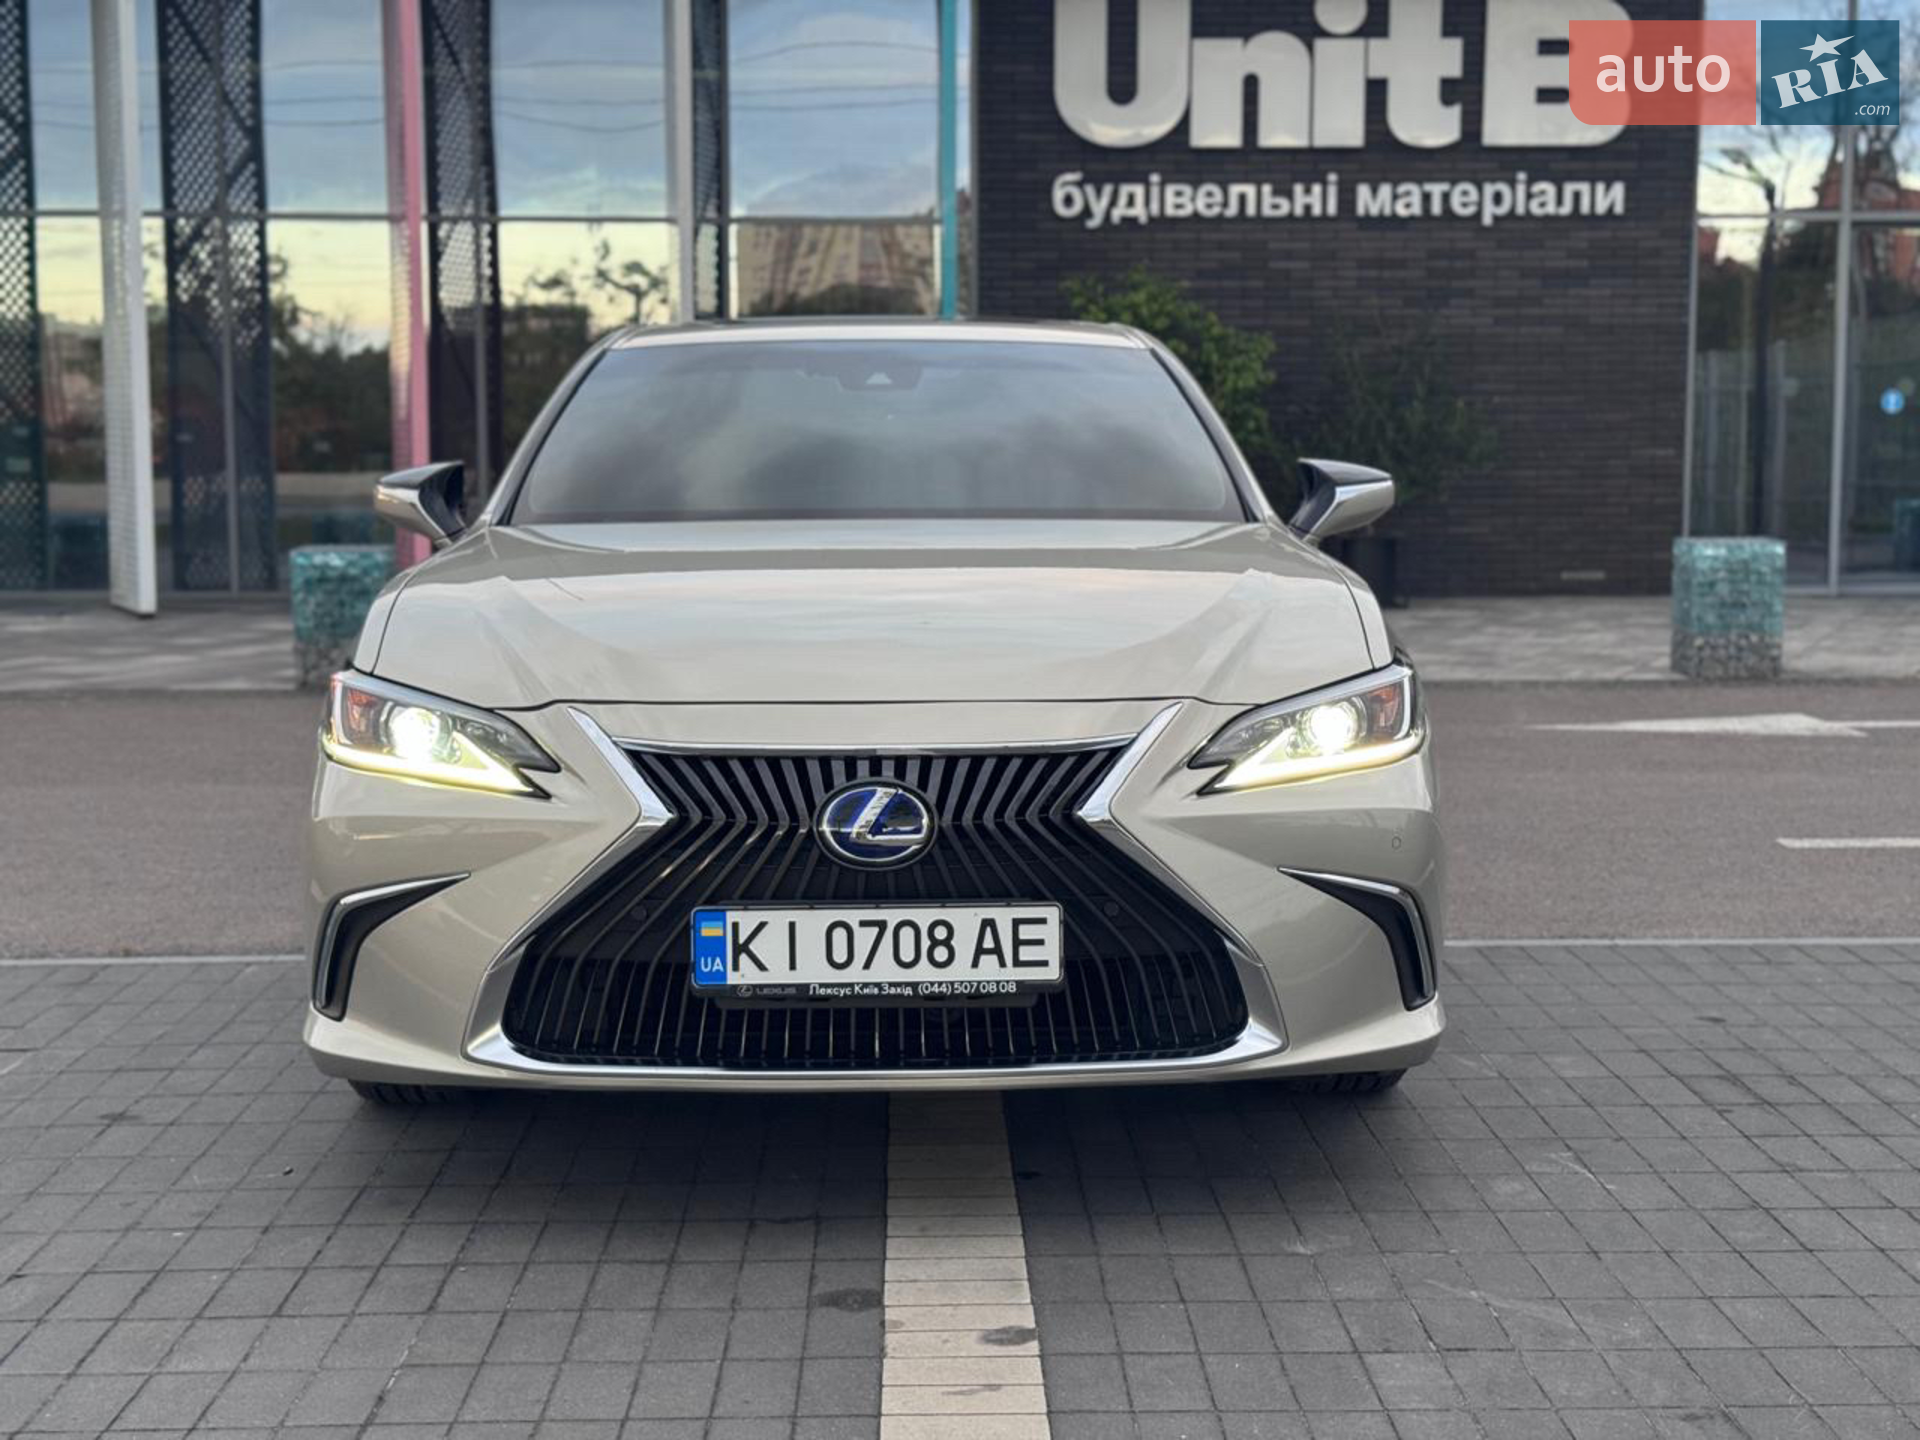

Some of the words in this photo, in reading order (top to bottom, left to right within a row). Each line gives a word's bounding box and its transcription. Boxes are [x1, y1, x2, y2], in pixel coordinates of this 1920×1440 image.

[1052, 173, 1339, 228] будівельні
[1355, 172, 1626, 227] матеріали
[825, 919, 956, 970] 0708
[971, 917, 1050, 969] AE
[700, 957, 724, 973] UA
[809, 984, 852, 997] Лексус
[854, 983, 879, 996] Київ
[881, 983, 913, 996] Захід
[918, 982, 952, 996] (044)
[953, 982, 978, 994] 507
